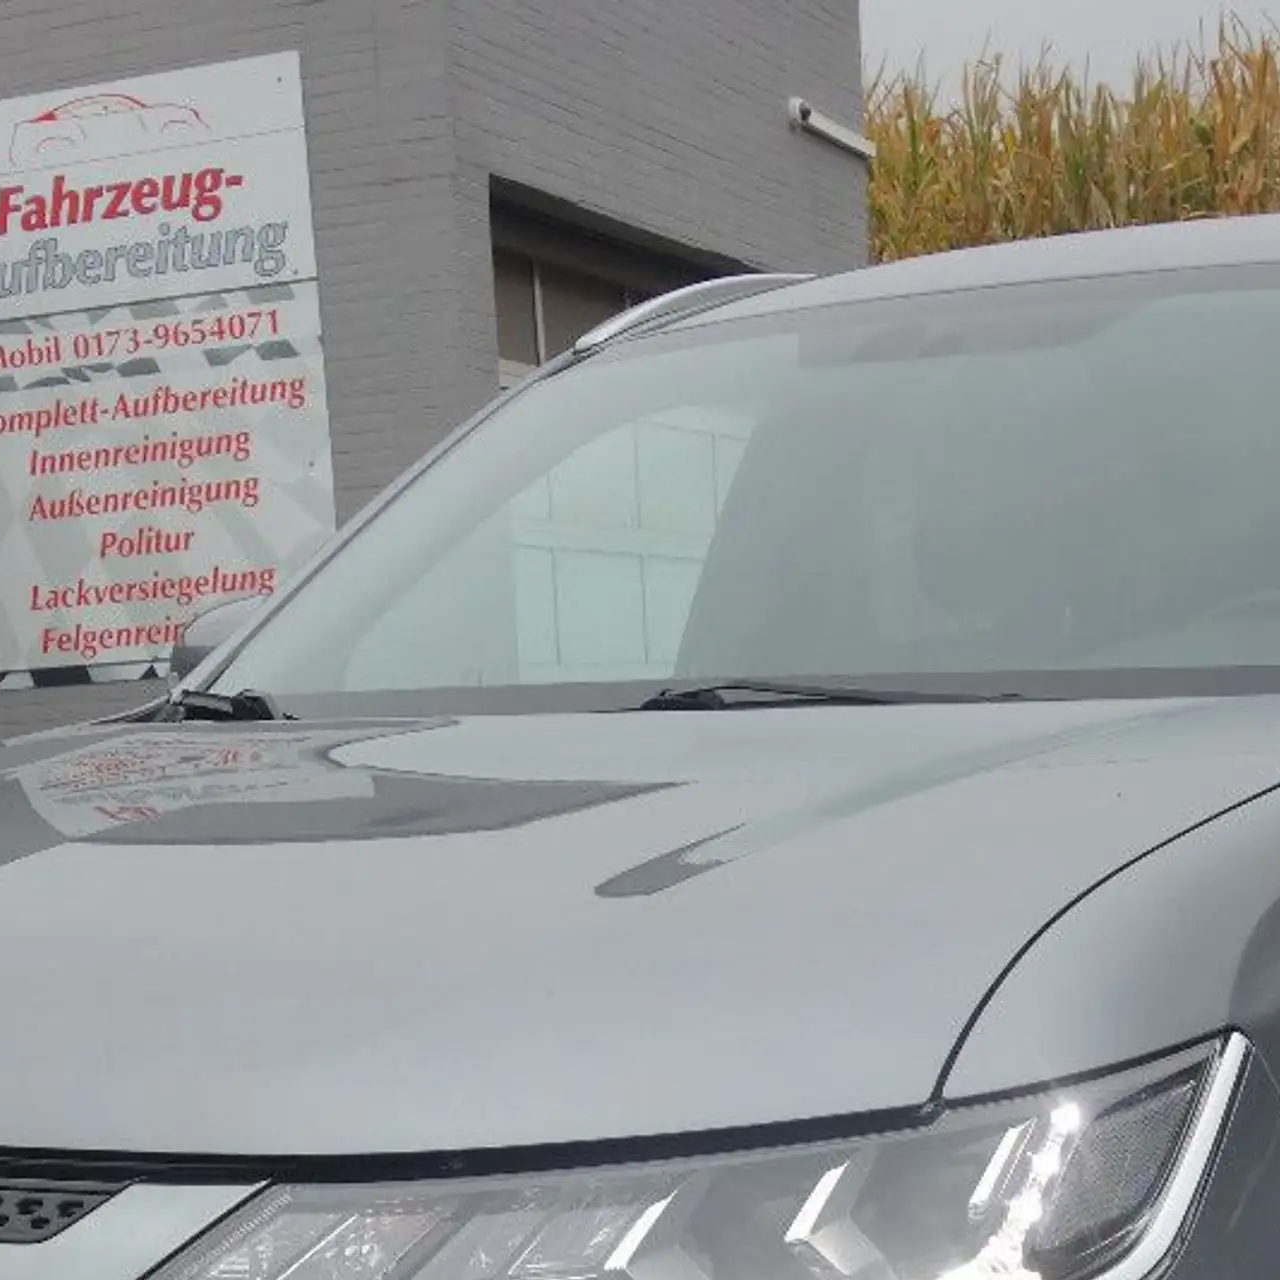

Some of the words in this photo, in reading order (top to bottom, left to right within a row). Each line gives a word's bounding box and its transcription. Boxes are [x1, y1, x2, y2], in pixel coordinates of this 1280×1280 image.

[73, 309, 280, 361] 0173-9654071
[28, 430, 252, 477] Innenreinigung
[28, 476, 260, 522] Außenreinigung
[99, 526, 196, 559] Politur
[29, 564, 277, 612] Lackversiegelung
